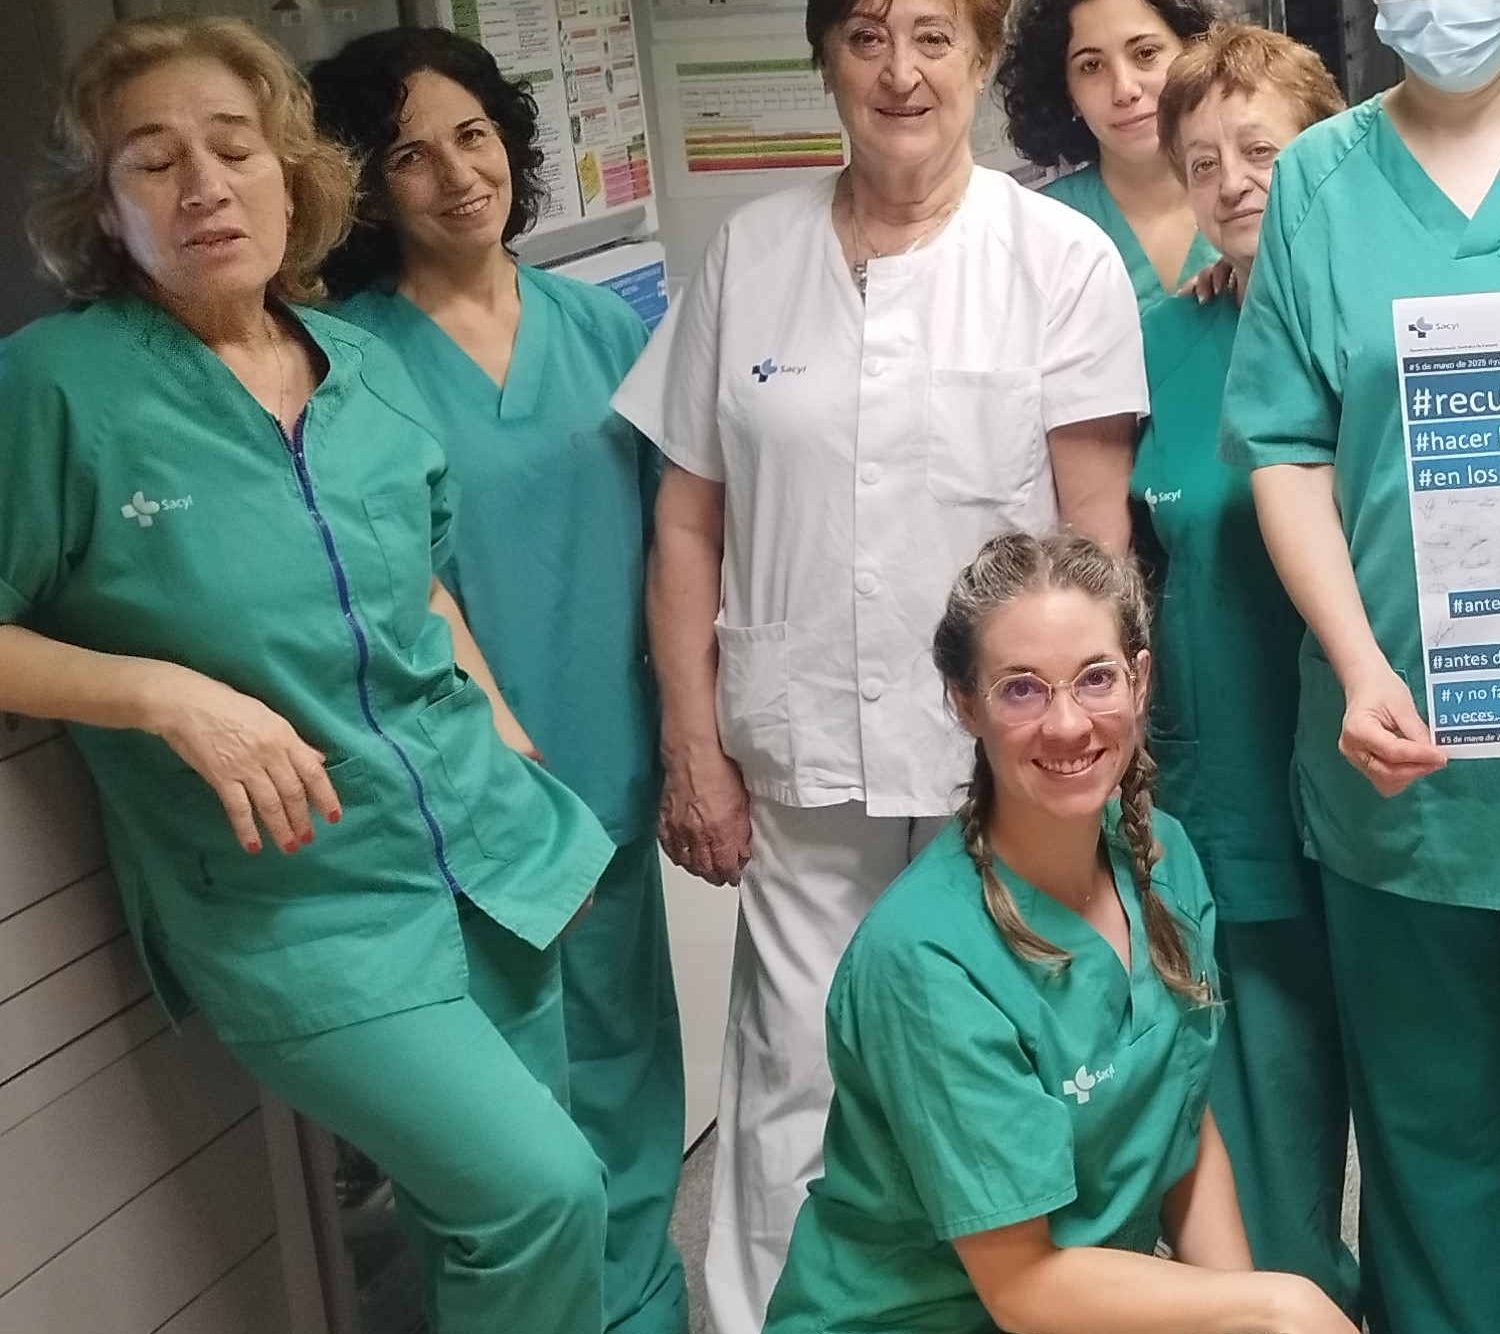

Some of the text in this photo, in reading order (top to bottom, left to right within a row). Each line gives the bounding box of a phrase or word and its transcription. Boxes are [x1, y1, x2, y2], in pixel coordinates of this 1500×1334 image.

[1415, 430, 1492, 452] #hacer
[1418, 468, 1461, 487] #en
[1467, 464, 1498, 485] los
[1159, 488, 1182, 502] Sacyl
[1432, 653, 1489, 670] #antes
[1441, 689, 1451, 703] #
[1454, 690, 1464, 704] y
[1468, 688, 1488, 701] no
[1439, 712, 1448, 725] a
